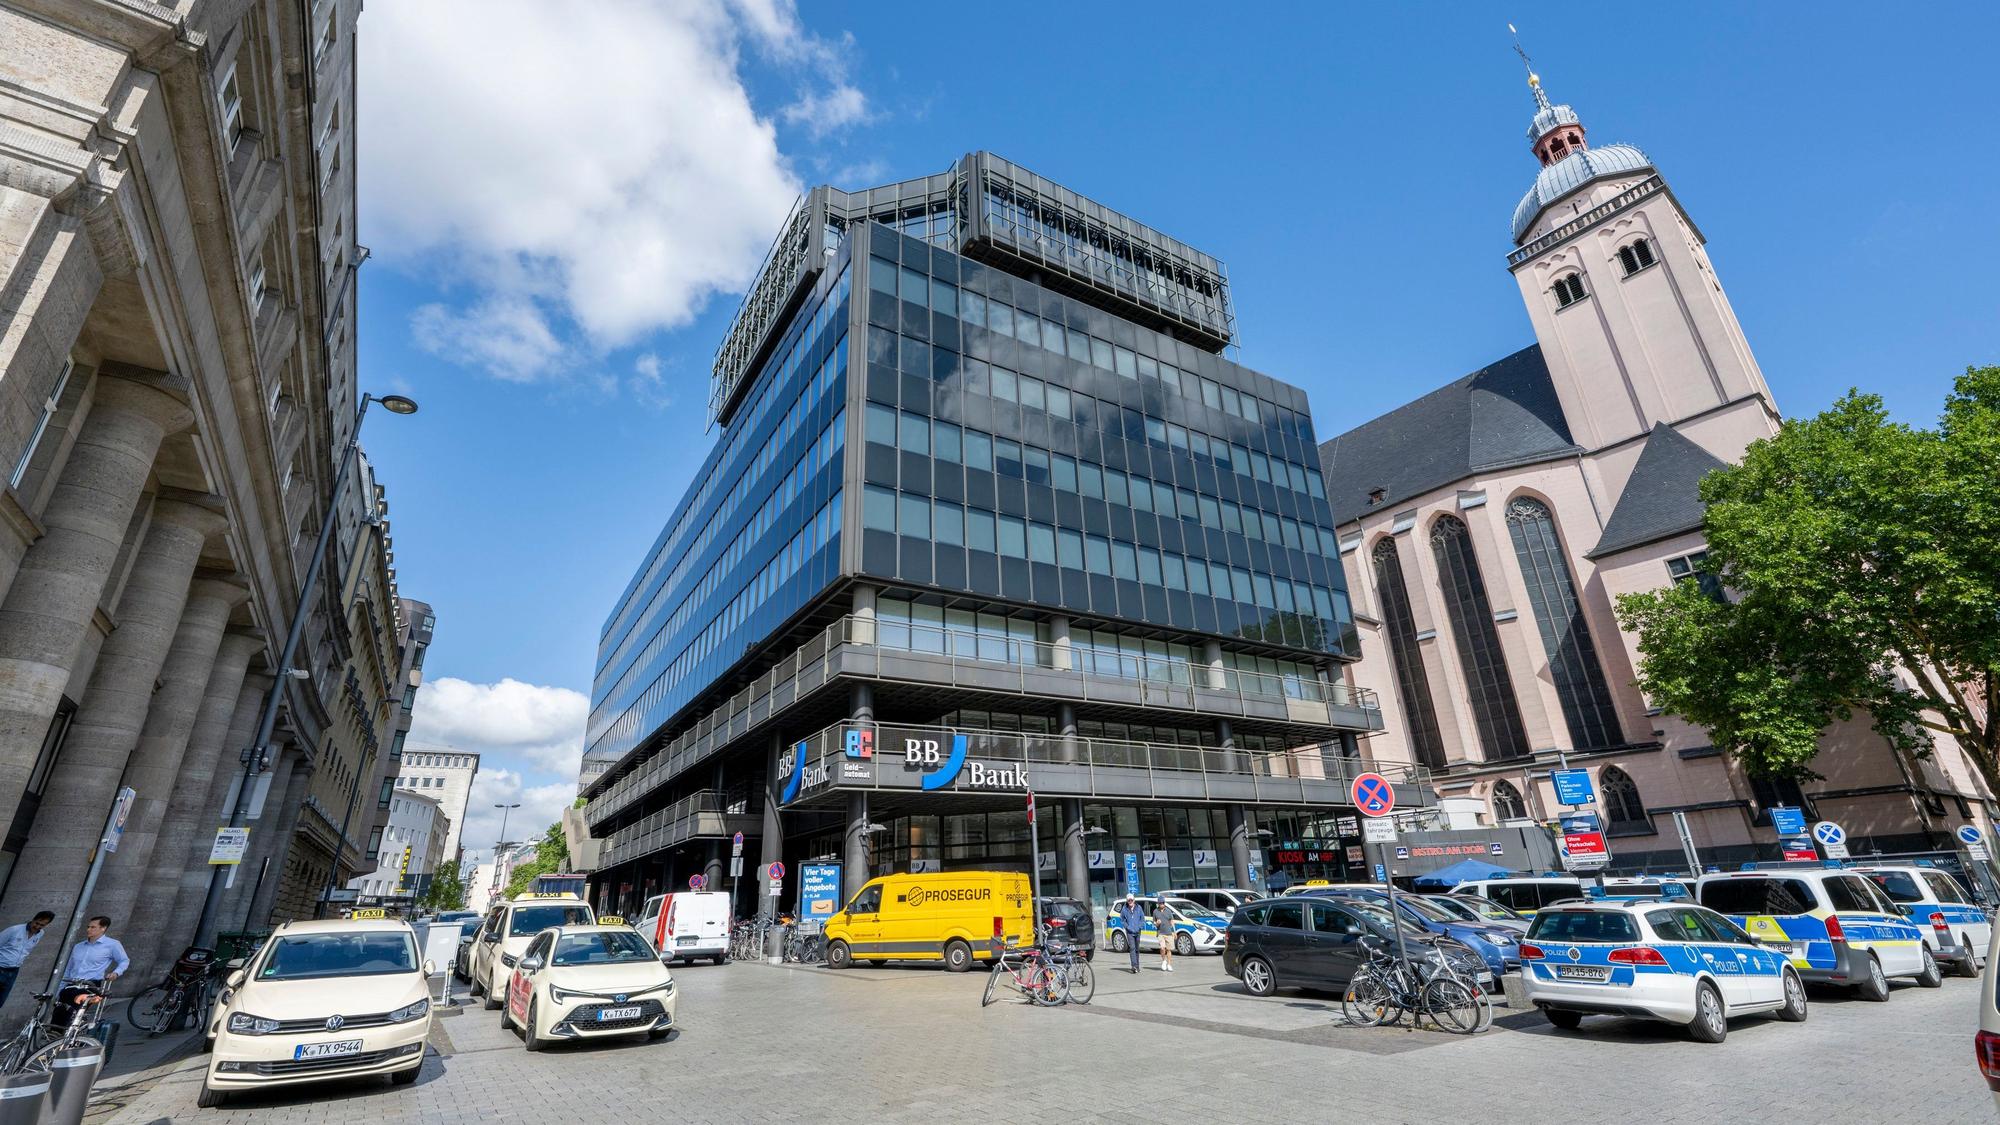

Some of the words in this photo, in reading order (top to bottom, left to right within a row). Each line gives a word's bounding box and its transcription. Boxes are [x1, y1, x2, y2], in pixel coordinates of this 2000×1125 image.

[905, 738, 940, 763] BB
[969, 762, 1030, 787] Bank
[778, 755, 792, 780] BB
[801, 762, 828, 790] Bank
[1277, 852, 1304, 863] KIOSK
[1308, 852, 1319, 861] AM
[400, 846, 411, 881] HOTEL
[805, 868, 819, 876] Vier
[820, 868, 836, 877] Tage
[804, 876, 823, 884] voller
[804, 883, 836, 893] Angebote
[925, 888, 991, 902] PROSEGUR
[1006, 893, 1029, 901] PROSEGUR
[360, 910, 381, 918] TAXI
[1713, 960, 1739, 972] POLIZEI
[1561, 967, 1572, 976] BP
